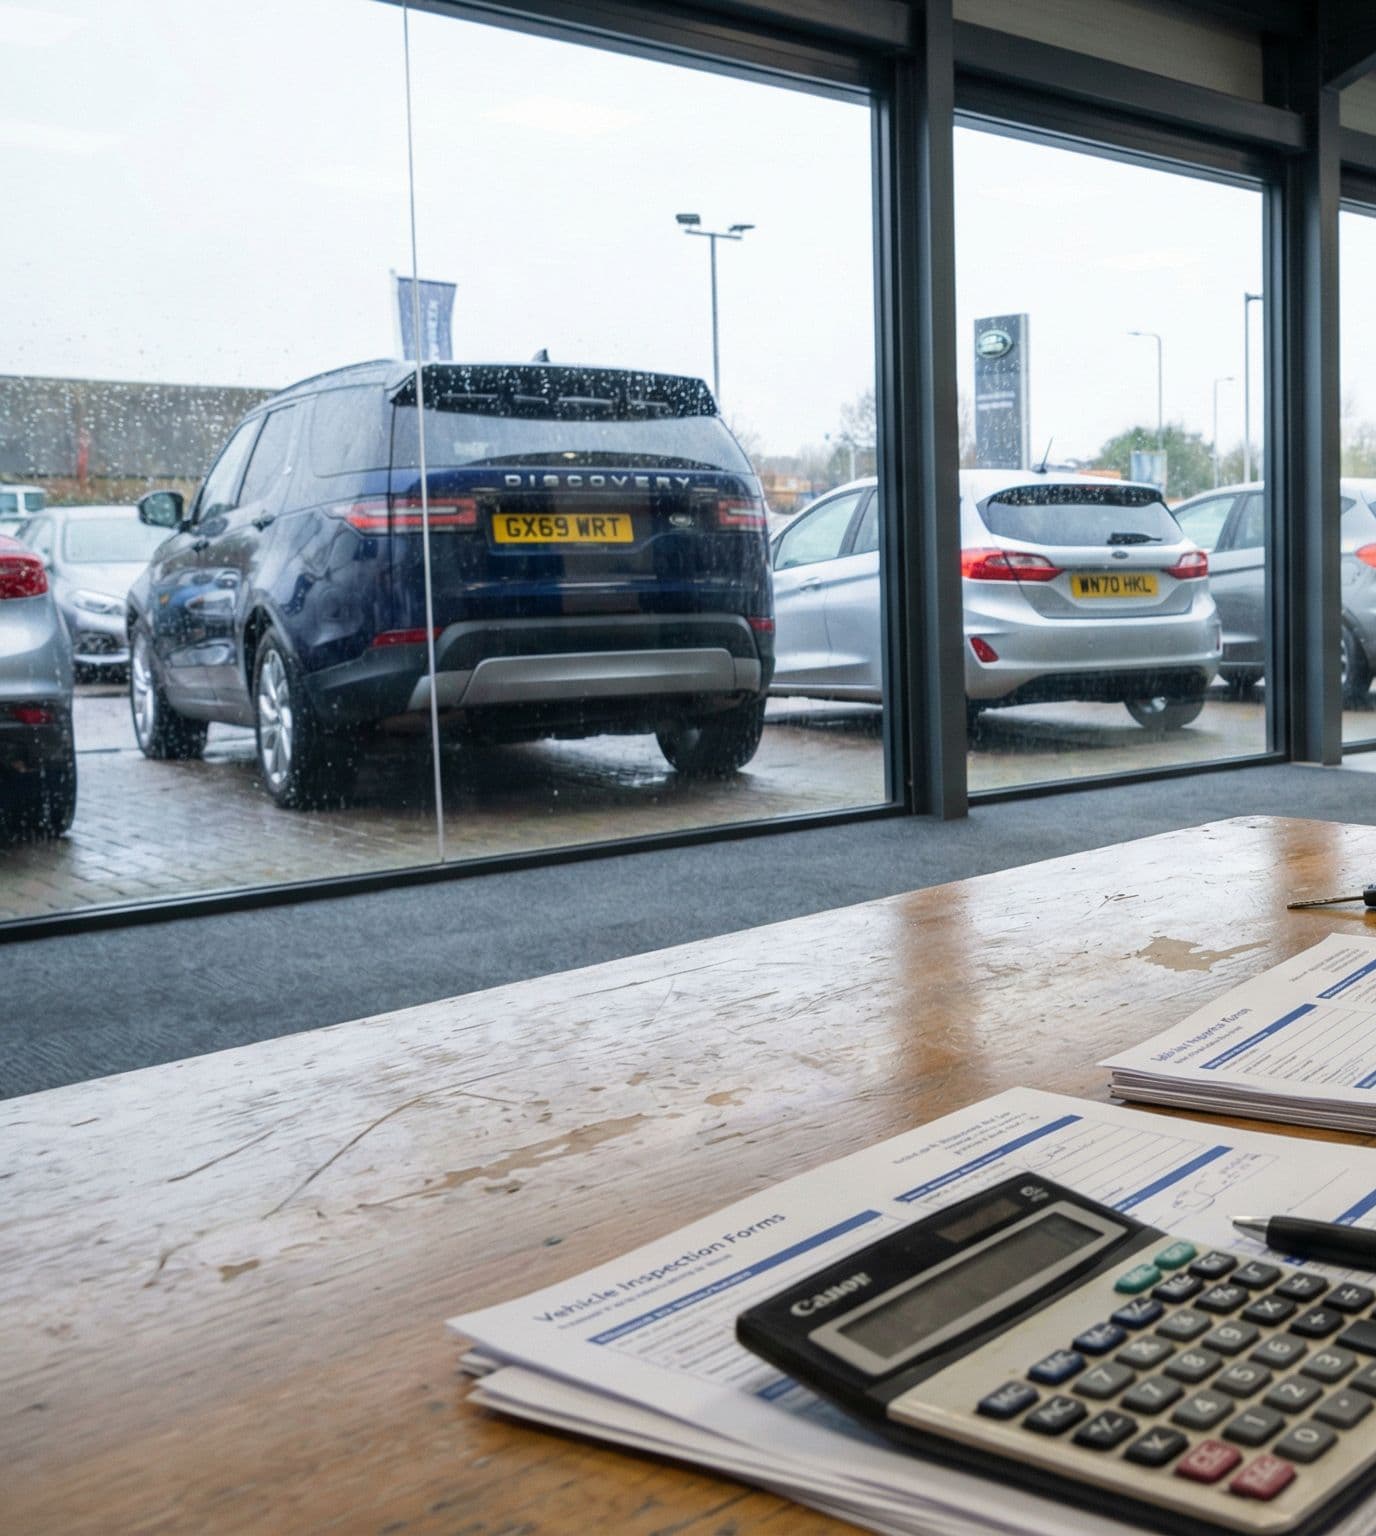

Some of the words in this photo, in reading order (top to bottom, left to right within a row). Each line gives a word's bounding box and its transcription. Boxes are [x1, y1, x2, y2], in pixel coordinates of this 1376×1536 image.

[504, 474, 690, 489] DISCOVERY
[505, 517, 569, 538] GX69
[576, 516, 621, 536] WRT
[532, 1286, 617, 1323] Vehicle
[617, 1240, 727, 1291] Inspection
[722, 1212, 787, 1245] Forms
